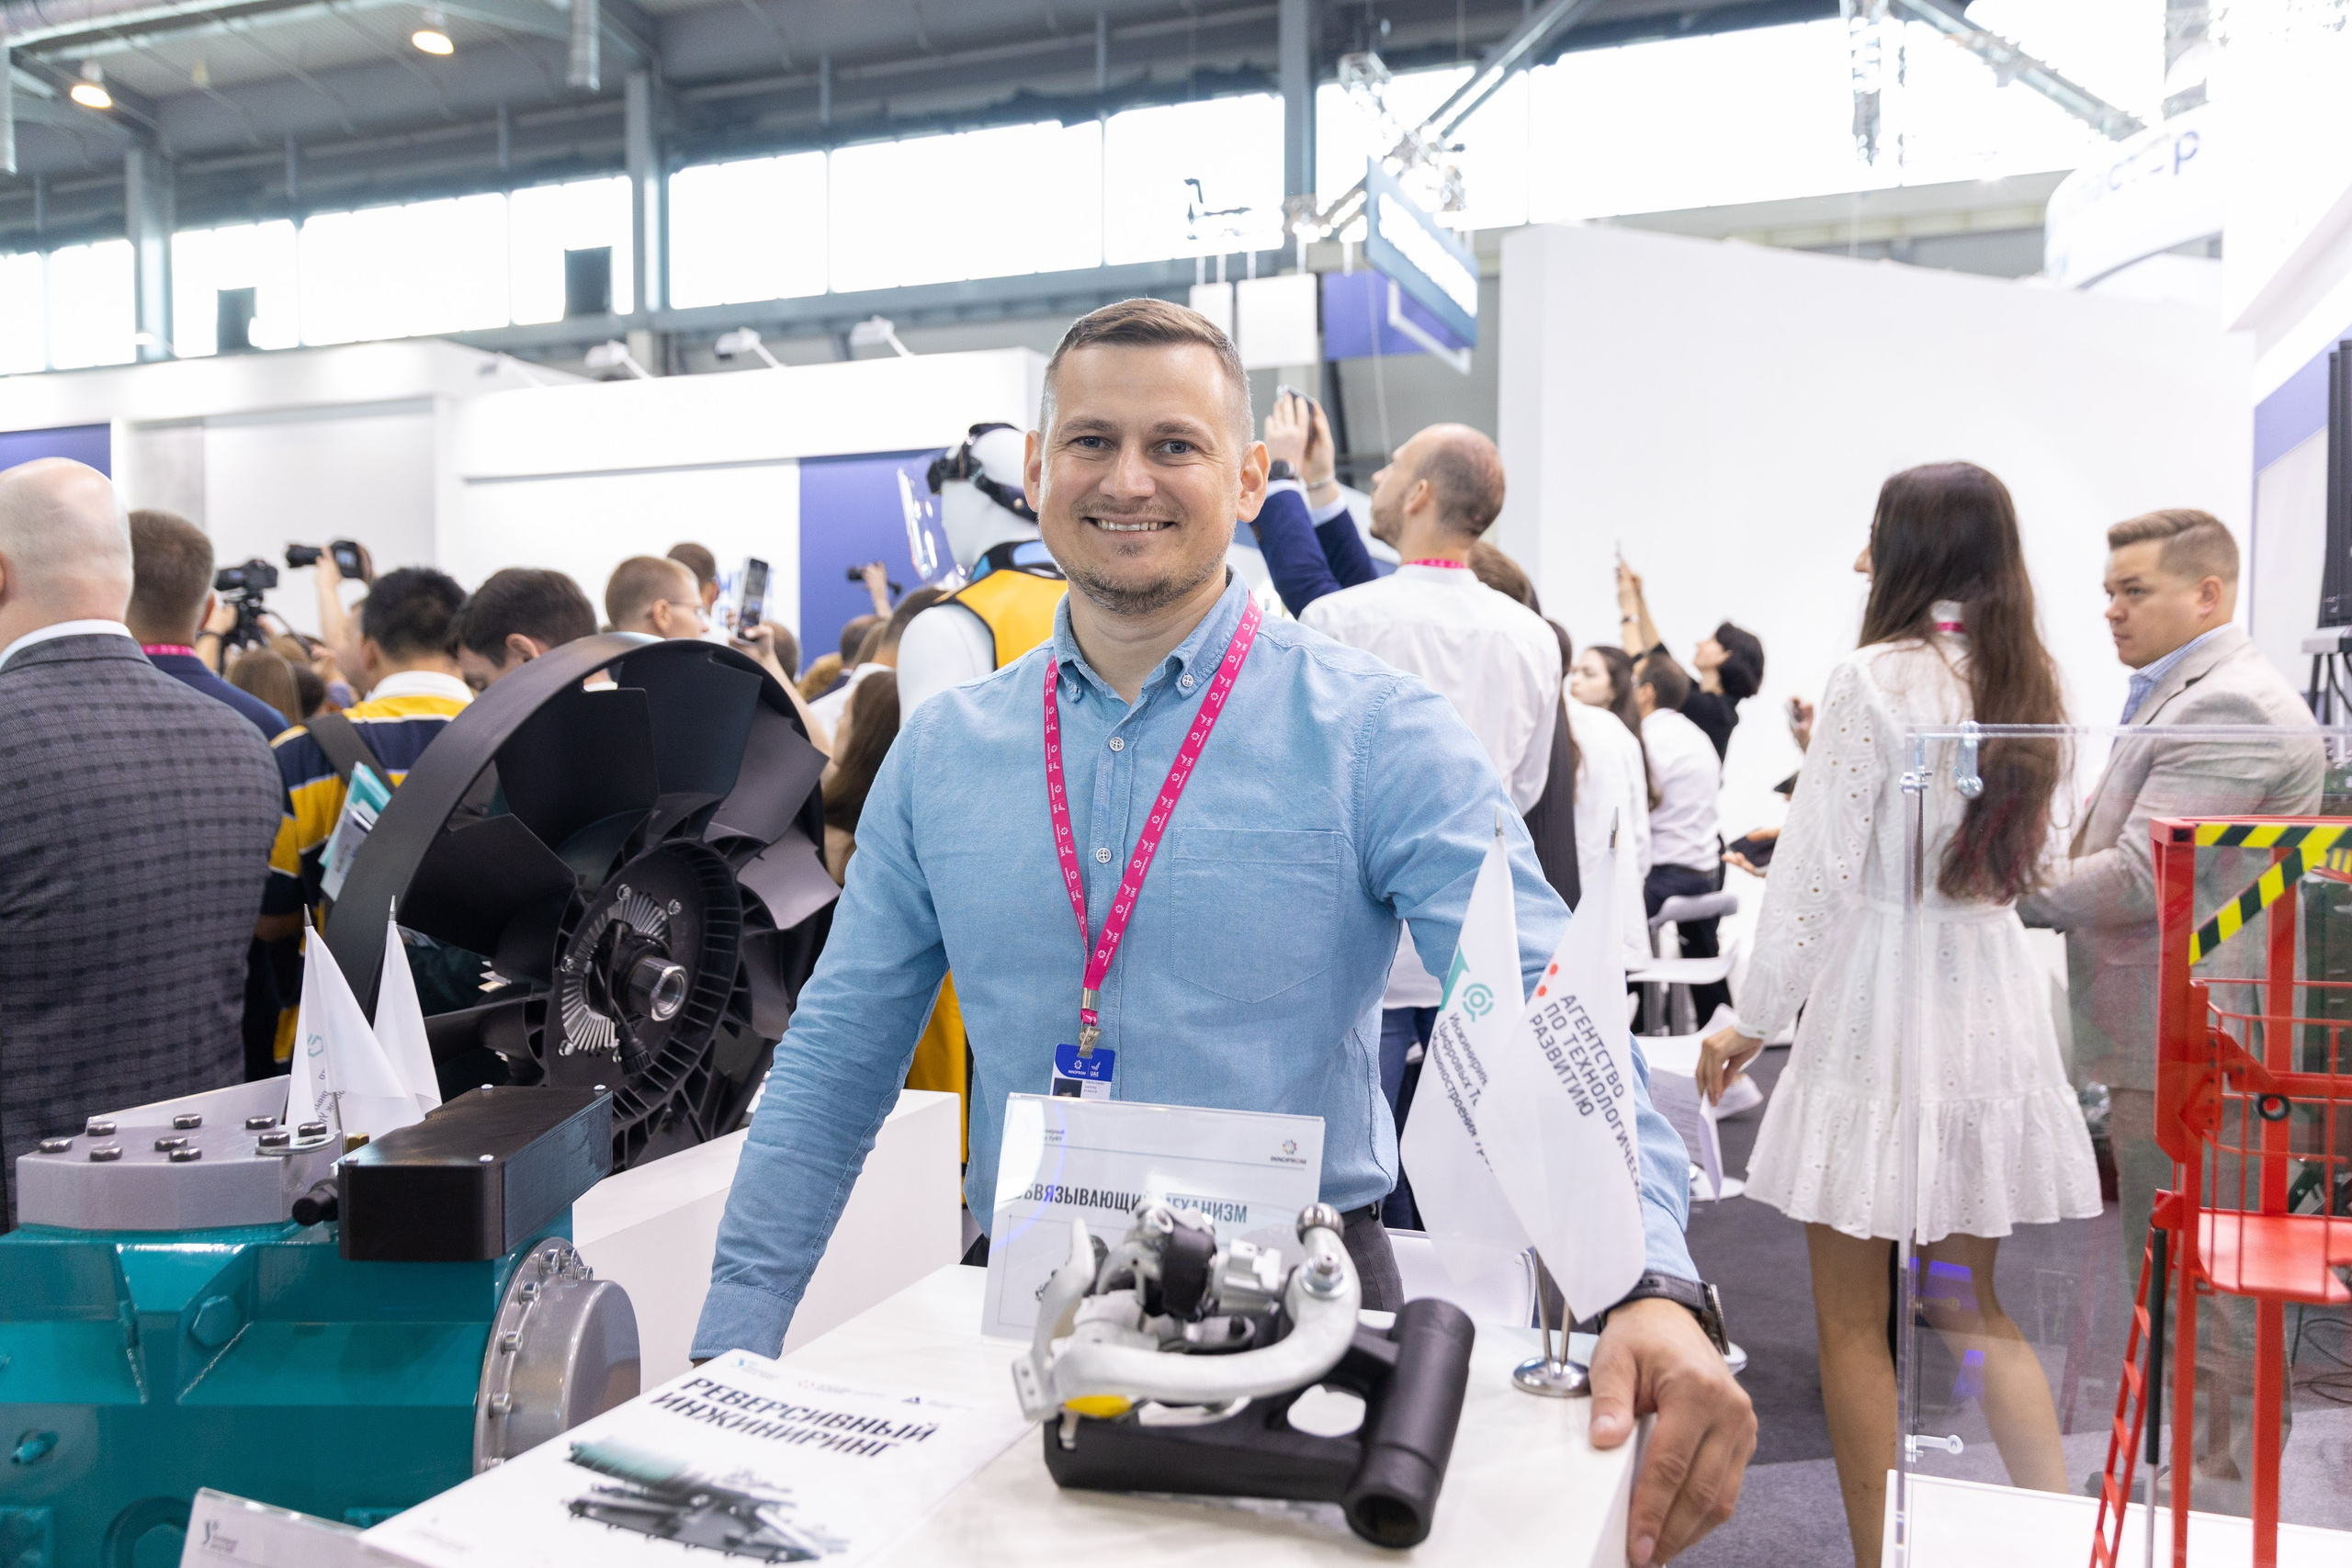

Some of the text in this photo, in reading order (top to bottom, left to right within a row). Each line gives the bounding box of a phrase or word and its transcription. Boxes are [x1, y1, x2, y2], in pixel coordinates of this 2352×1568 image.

[1205, 717, 1214, 727] UAE
[1186, 757, 1194, 767] UAE
[1166, 798, 1174, 809] UAE
[1147, 841, 1156, 853] UAE
[1129, 886, 1137, 898] UAE
[1112, 931, 1120, 943] UAE
[1544, 1002, 1567, 1031] ПО
[1438, 1021, 1473, 1089] Цифровых
[1560, 994, 1624, 1099] АГЕНТСТВО
[1529, 1013, 1595, 1118] РАЗВИТИЮ
[680, 1377, 940, 1442] РЕВЕРСИВНЫЙ
[650, 1392, 899, 1457] ИНЖИНИРИНГ
